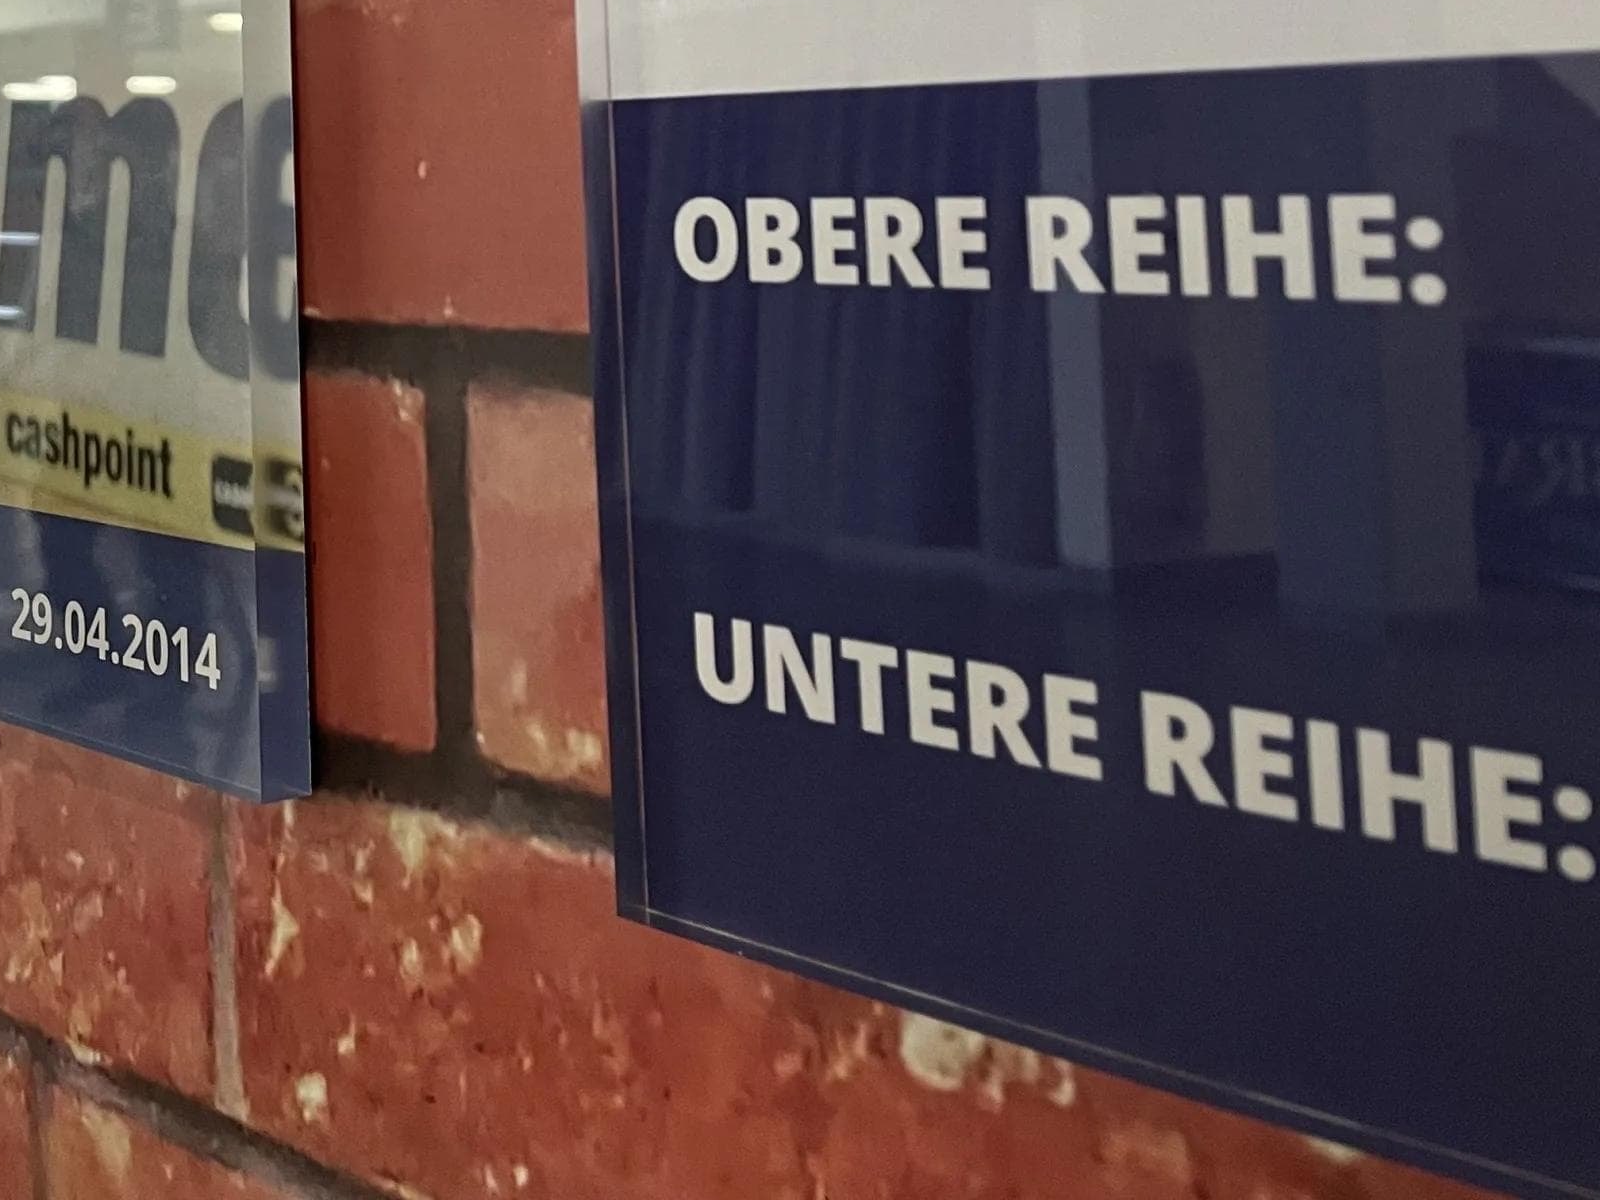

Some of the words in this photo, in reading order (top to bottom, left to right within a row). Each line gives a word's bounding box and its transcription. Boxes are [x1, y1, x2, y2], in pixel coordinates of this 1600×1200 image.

[673, 194, 992, 291] OBERE
[1024, 193, 1448, 307] REIHE:
[6, 411, 173, 499] cashpoint
[10, 587, 222, 691] 29.04.2014
[693, 611, 1104, 782] UNTERE
[1140, 689, 1597, 883] REIHE:
